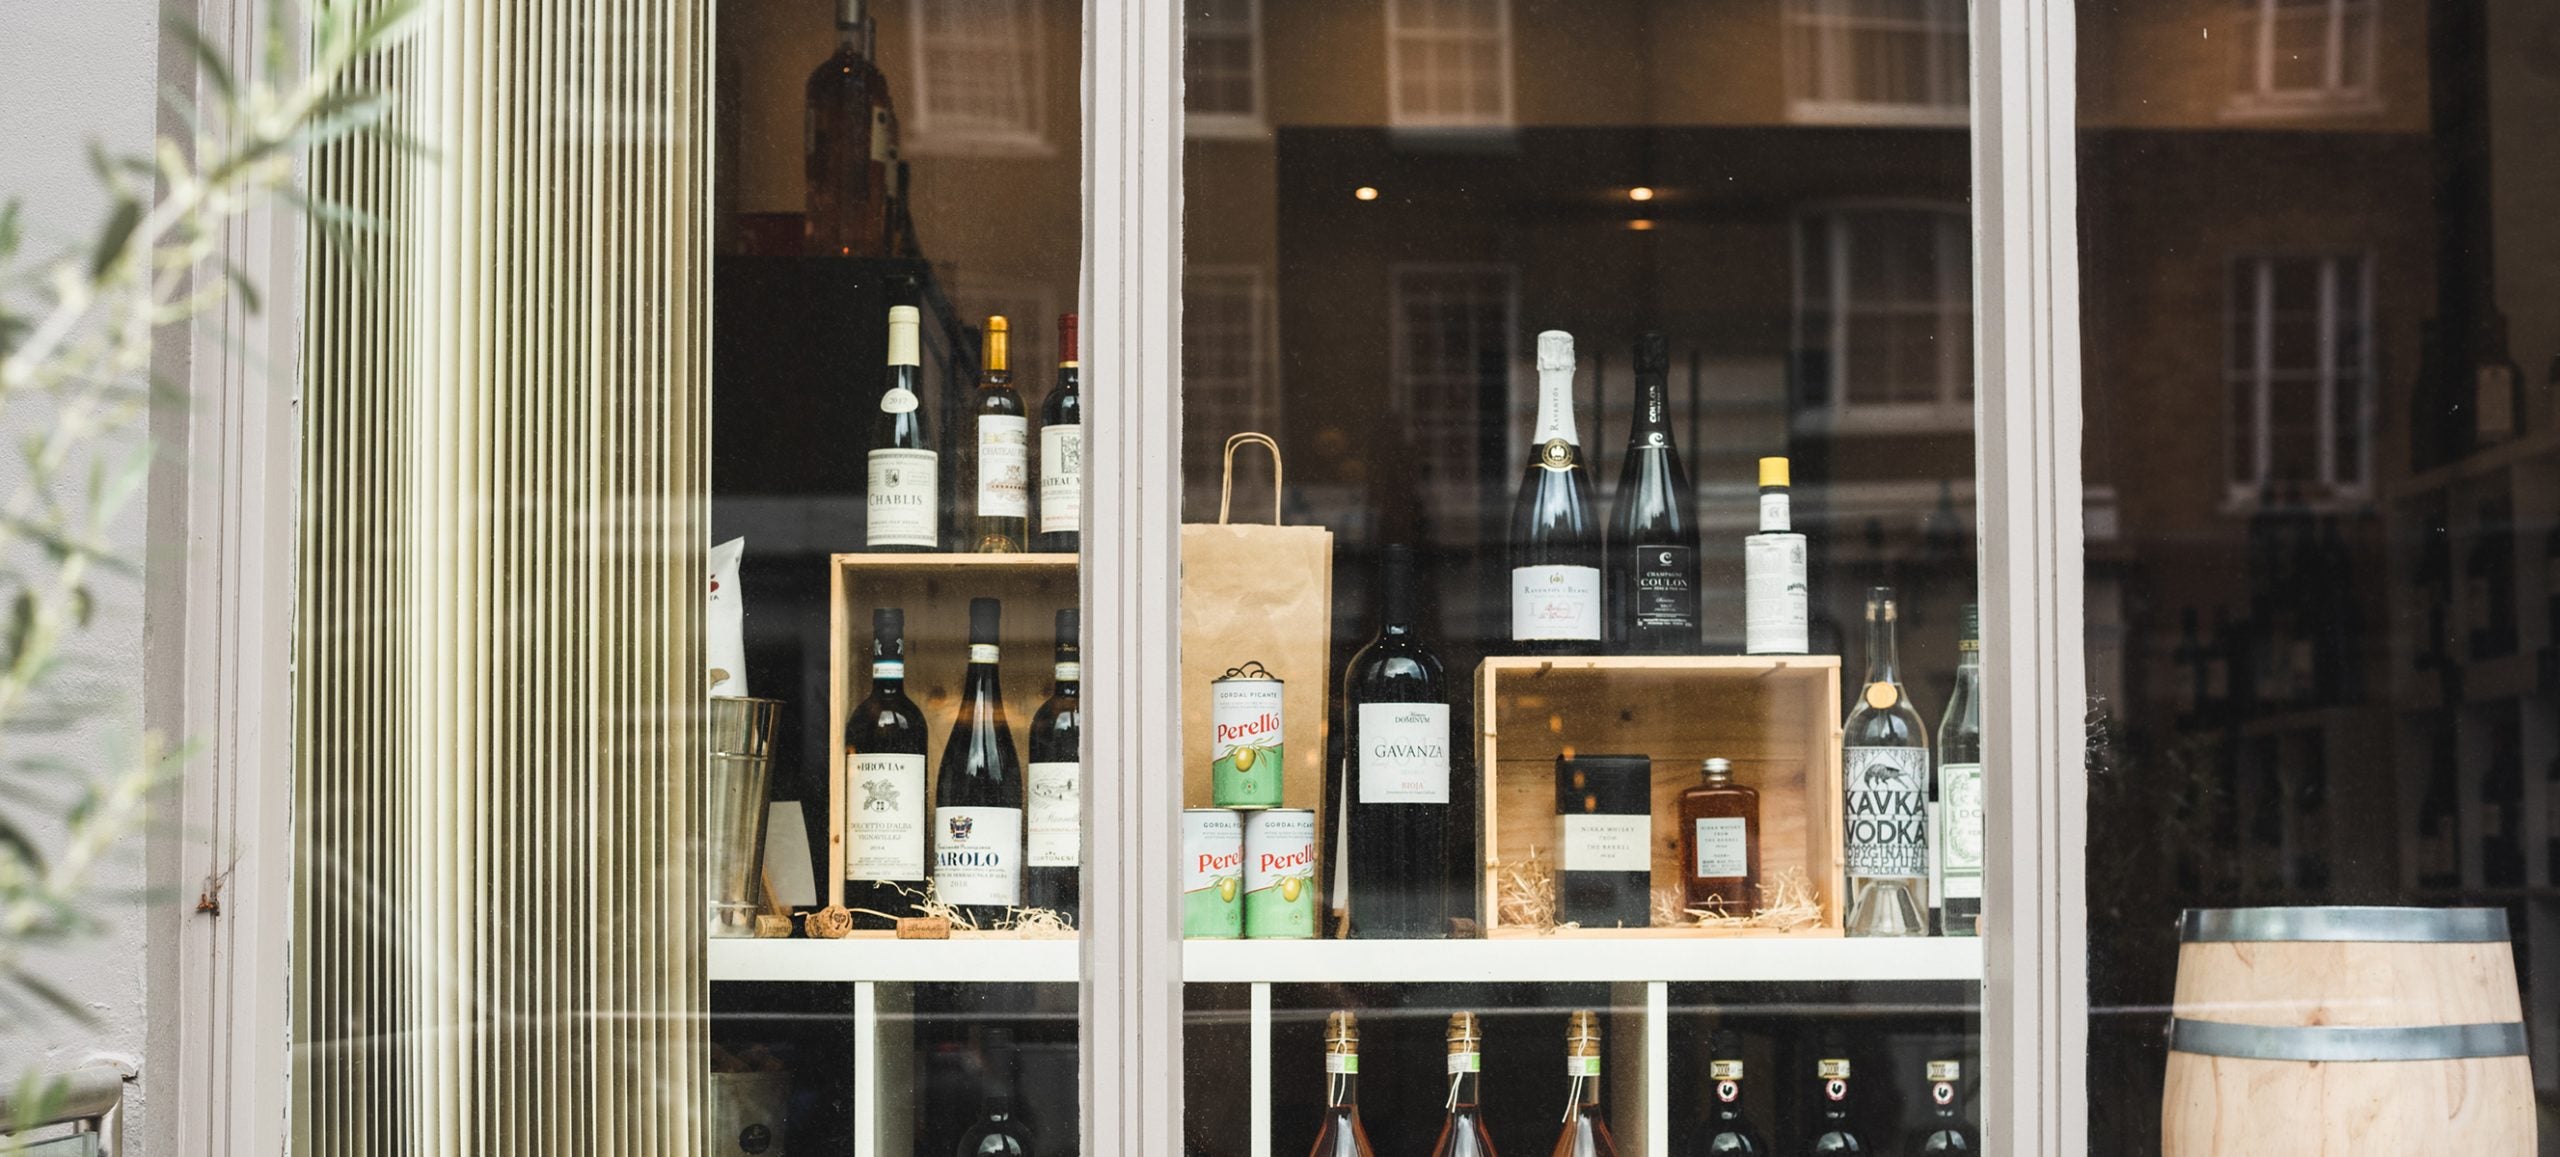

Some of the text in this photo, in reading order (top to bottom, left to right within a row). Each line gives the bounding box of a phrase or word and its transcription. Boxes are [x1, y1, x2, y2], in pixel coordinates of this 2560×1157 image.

[869, 493, 923, 506] CHABLIS
[1640, 578, 1688, 587] COULON
[1217, 713, 1280, 743] Perelló
[1374, 745, 1443, 758] GAVANZA
[861, 762, 899, 771] BROVIA
[1845, 791, 1926, 817] KAVKA
[1845, 820, 1926, 845] VODKA
